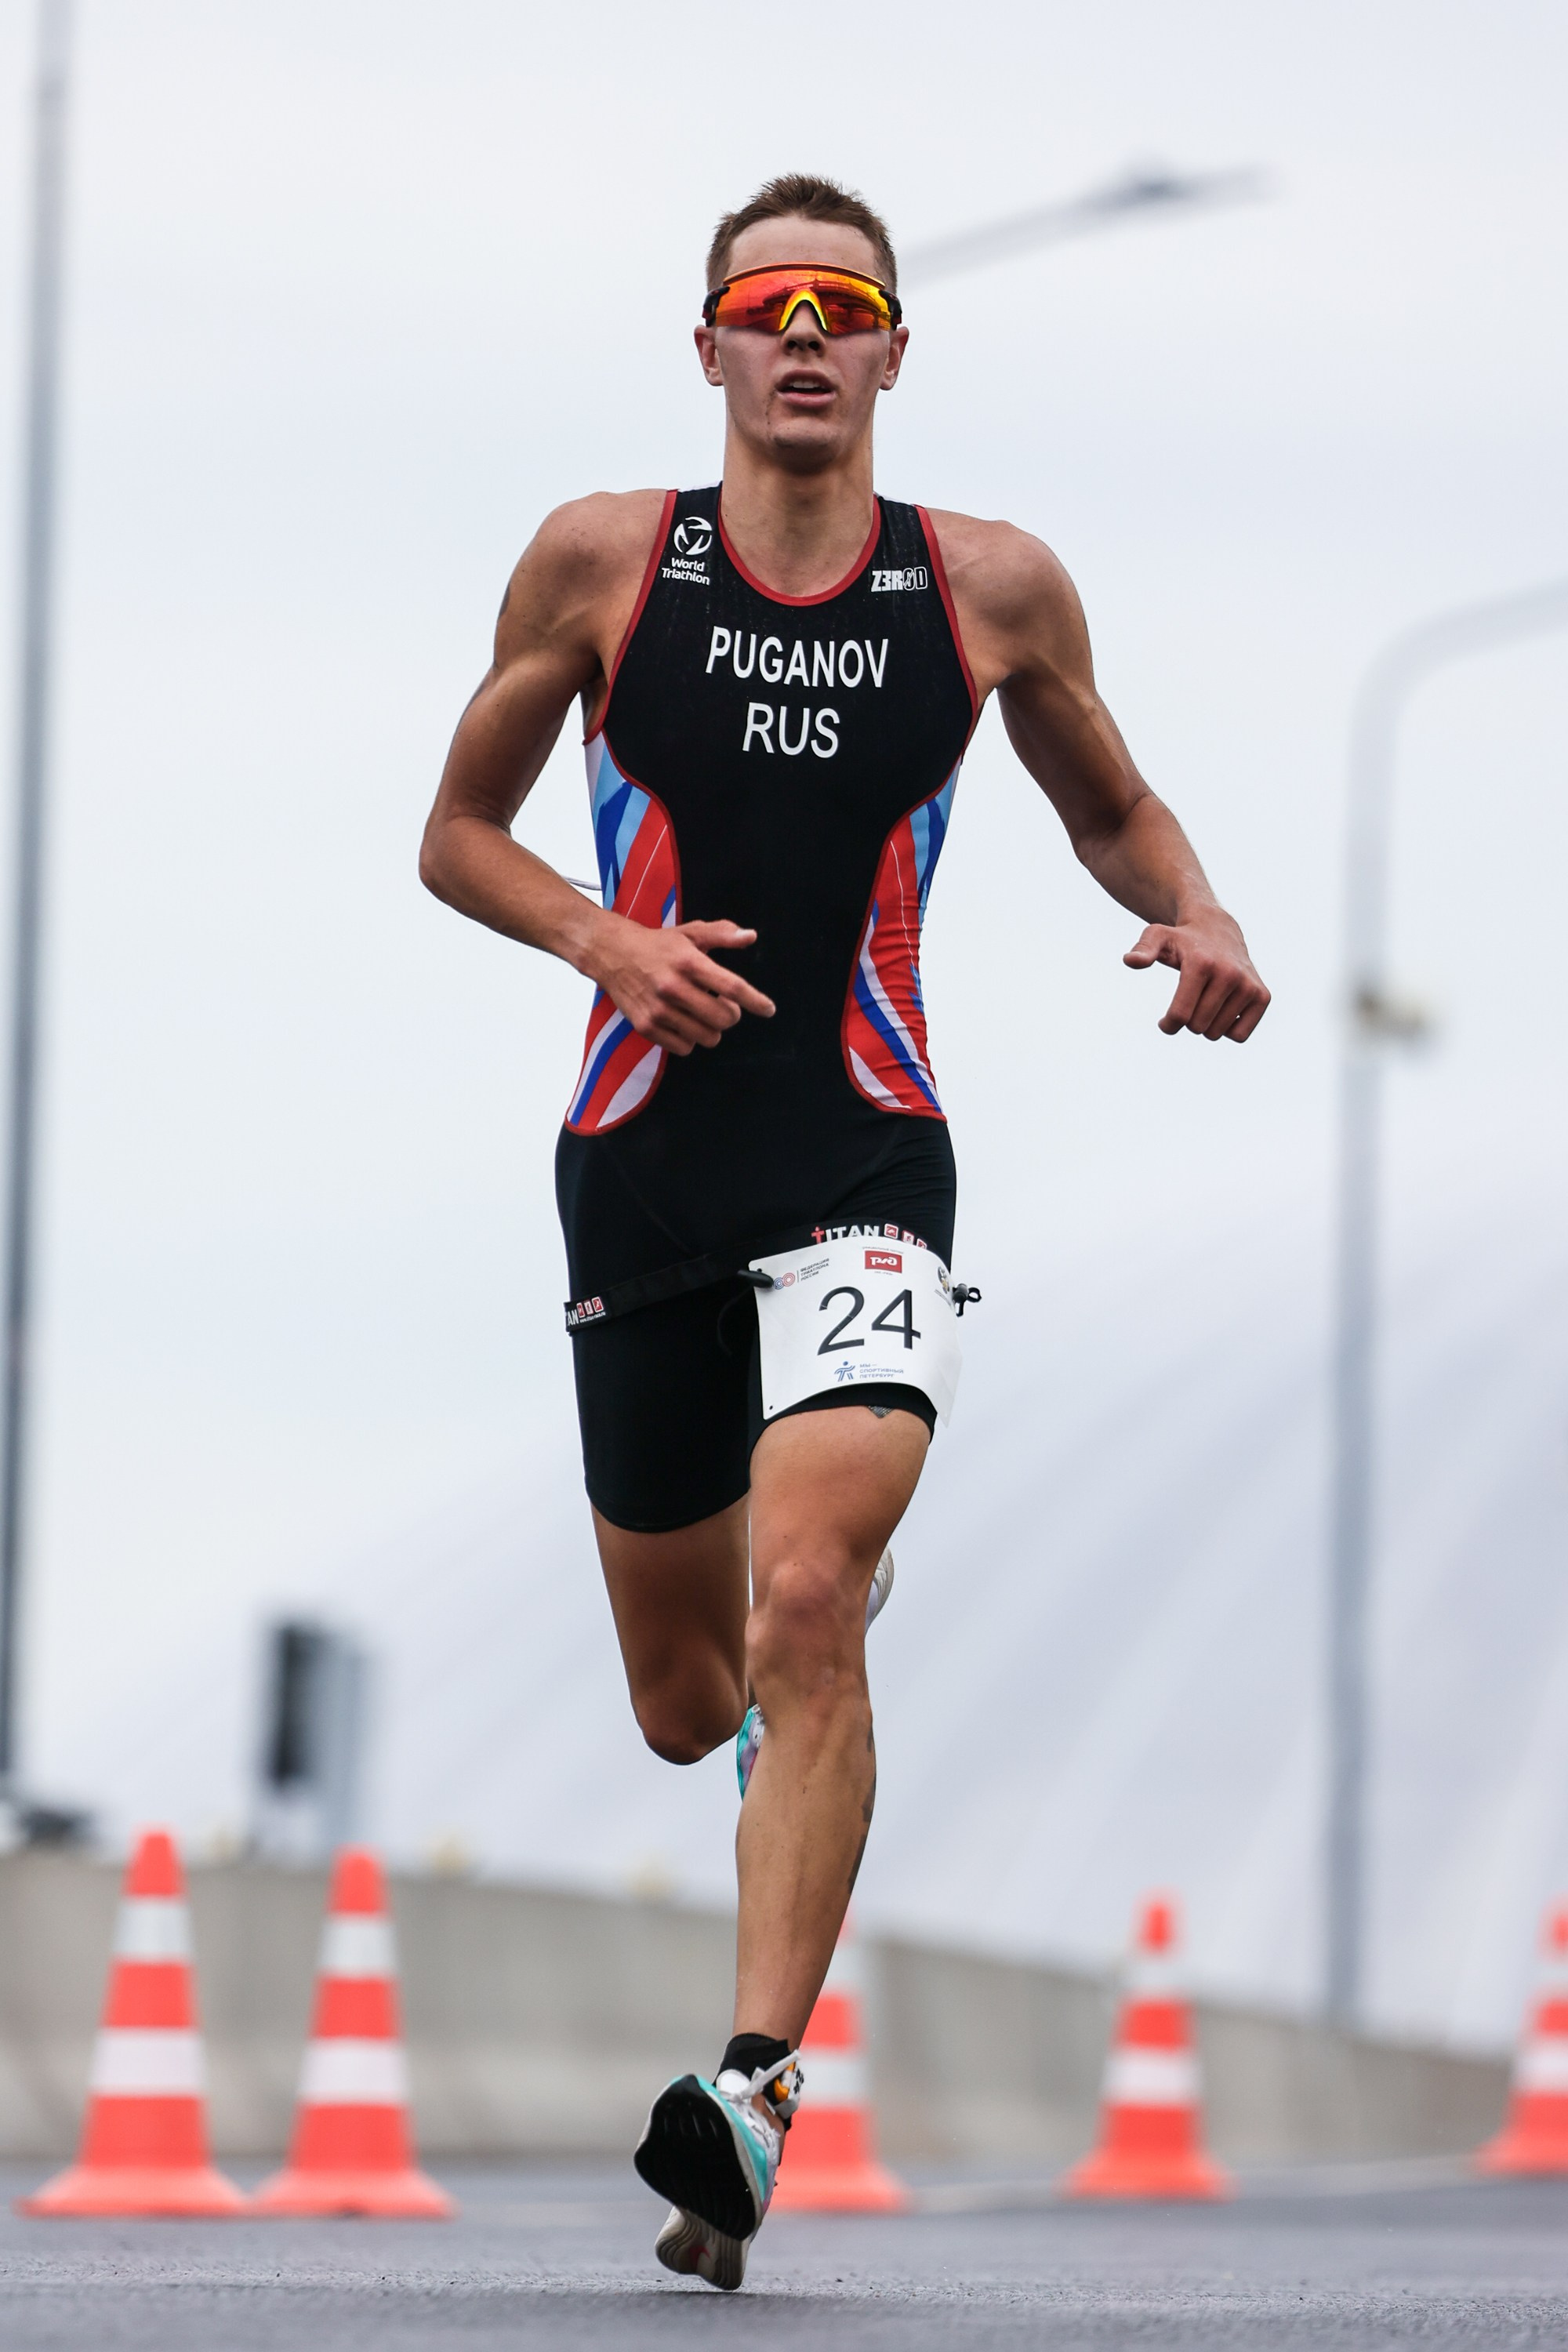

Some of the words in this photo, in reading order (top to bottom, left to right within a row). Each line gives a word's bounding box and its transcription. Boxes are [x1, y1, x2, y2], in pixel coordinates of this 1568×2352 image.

[661, 567, 710, 586] Triathlon
[671, 557, 705, 572] World
[705, 626, 888, 688] PUGANOV
[742, 702, 840, 758] RUS
[817, 1286, 921, 1356] 24
